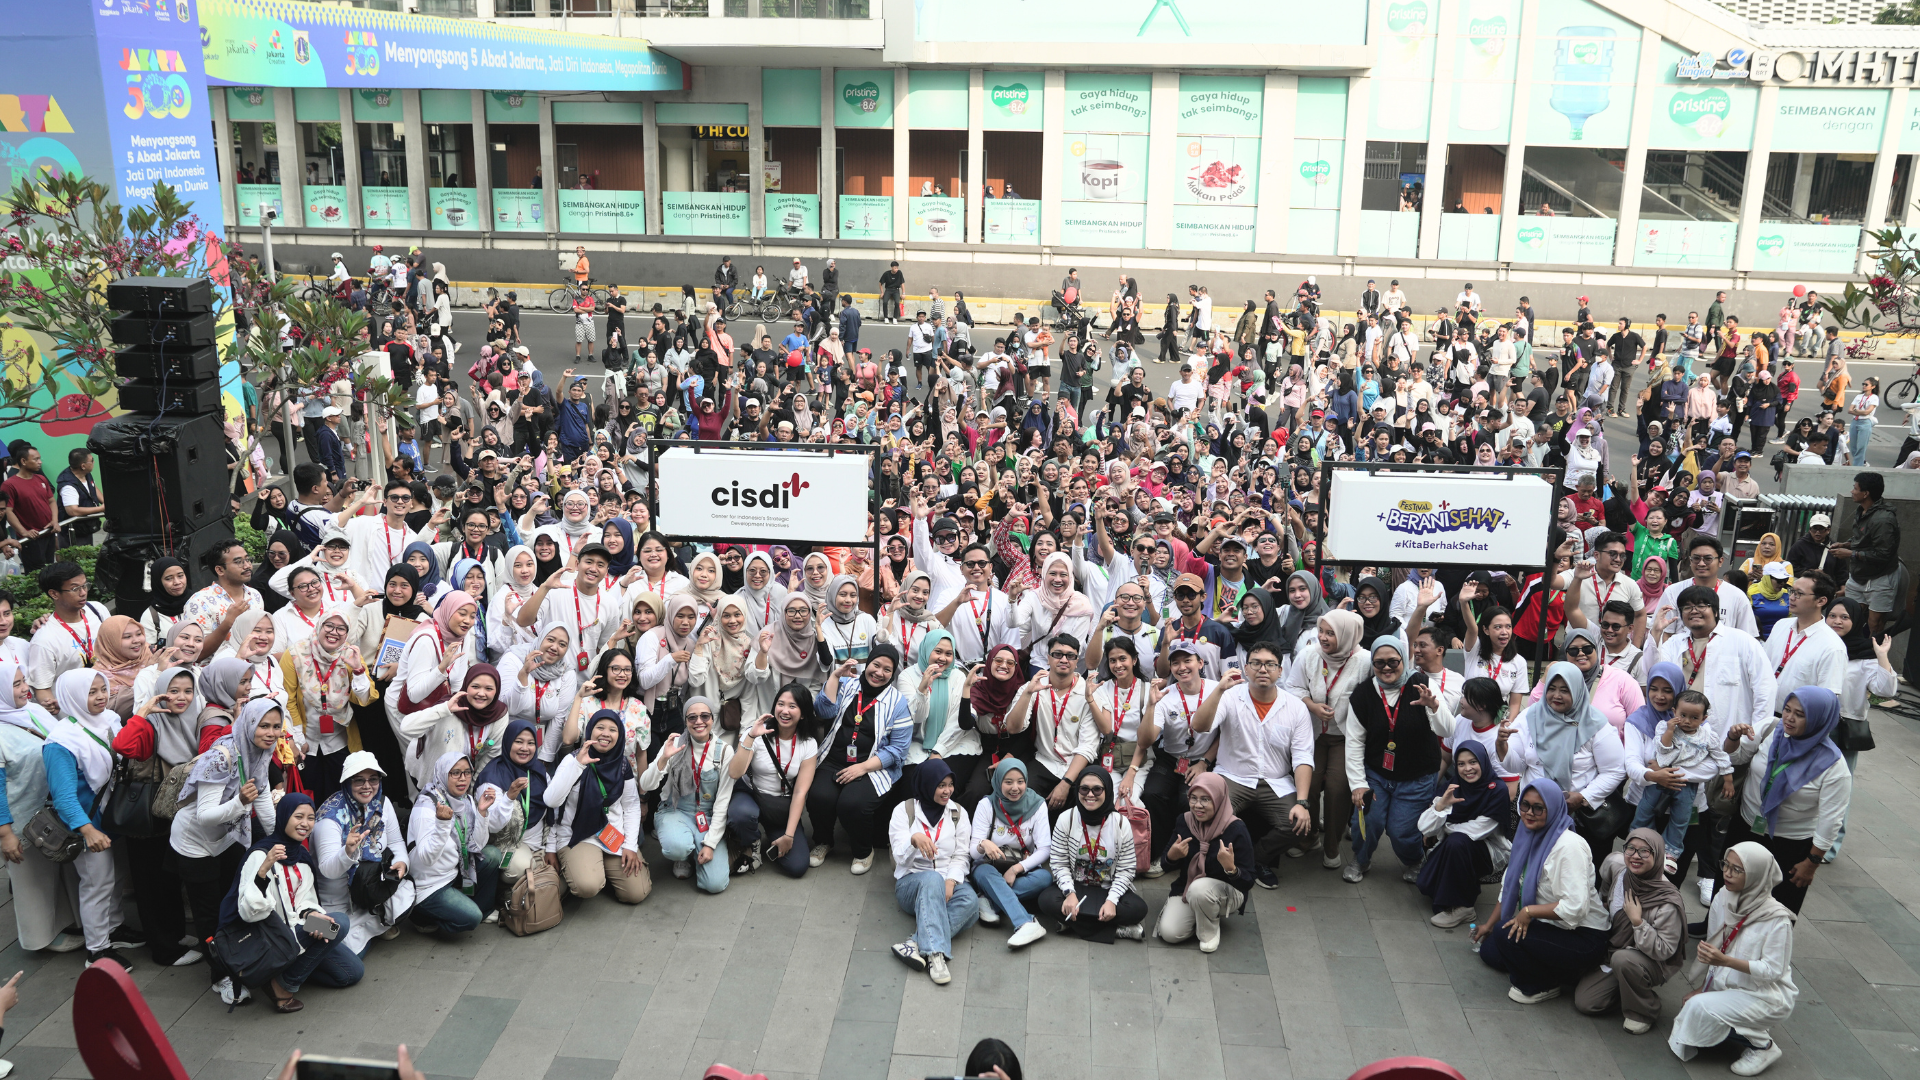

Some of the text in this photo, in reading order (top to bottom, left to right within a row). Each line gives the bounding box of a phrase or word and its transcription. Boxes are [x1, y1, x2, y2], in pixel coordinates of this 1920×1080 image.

[1390, 8, 1426, 20] pristine
[1470, 24, 1506, 36] pristine
[343, 30, 378, 46] JAKARTA
[226, 45, 249, 56] jakarta
[266, 50, 285, 58] Jakarta
[119, 48, 187, 72] JAKARTA
[385, 41, 667, 78] Menyongsong 5 Abad Jakarta, Jati Diri Indonesia, Megapolitan Dunia
[1680, 58, 1697, 66] Jak
[1679, 67, 1712, 78] Lingko
[124, 73, 192, 120] 500
[846, 87, 877, 98] pristine
[994, 89, 1026, 100] pristine
[1080, 89, 1138, 102] Gaya hidup
[1191, 92, 1250, 106] Gaya hidup
[1071, 101, 1146, 118] tak seimbang?
[1182, 104, 1258, 120] tak seimbang?
[1673, 99, 1726, 114] pristine
[1780, 106, 1876, 116] SEIMBANGKAN
[727, 126, 749, 137] CU
[1822, 120, 1873, 133] dengan
[131, 134, 196, 149] Menyongsong
[127, 148, 200, 164] 5 Abad Jakarta
[126, 164, 205, 182] Jati Diri Indonesia
[184, 179, 208, 192] Dunia
[1082, 172, 1118, 190] Kopi
[1188, 181, 1246, 202] Makan Pedas
[618, 202, 640, 210] HIDUP
[723, 204, 746, 212] HIDUP
[446, 214, 464, 222] Kopi
[673, 212, 699, 220] dengan
[1176, 222, 1230, 230] SEIMBANGKAN
[711, 480, 789, 509] cisdi
[1400, 500, 1430, 512] FESTIVAL
[1395, 540, 1488, 550] #KitaBerhakSehat
